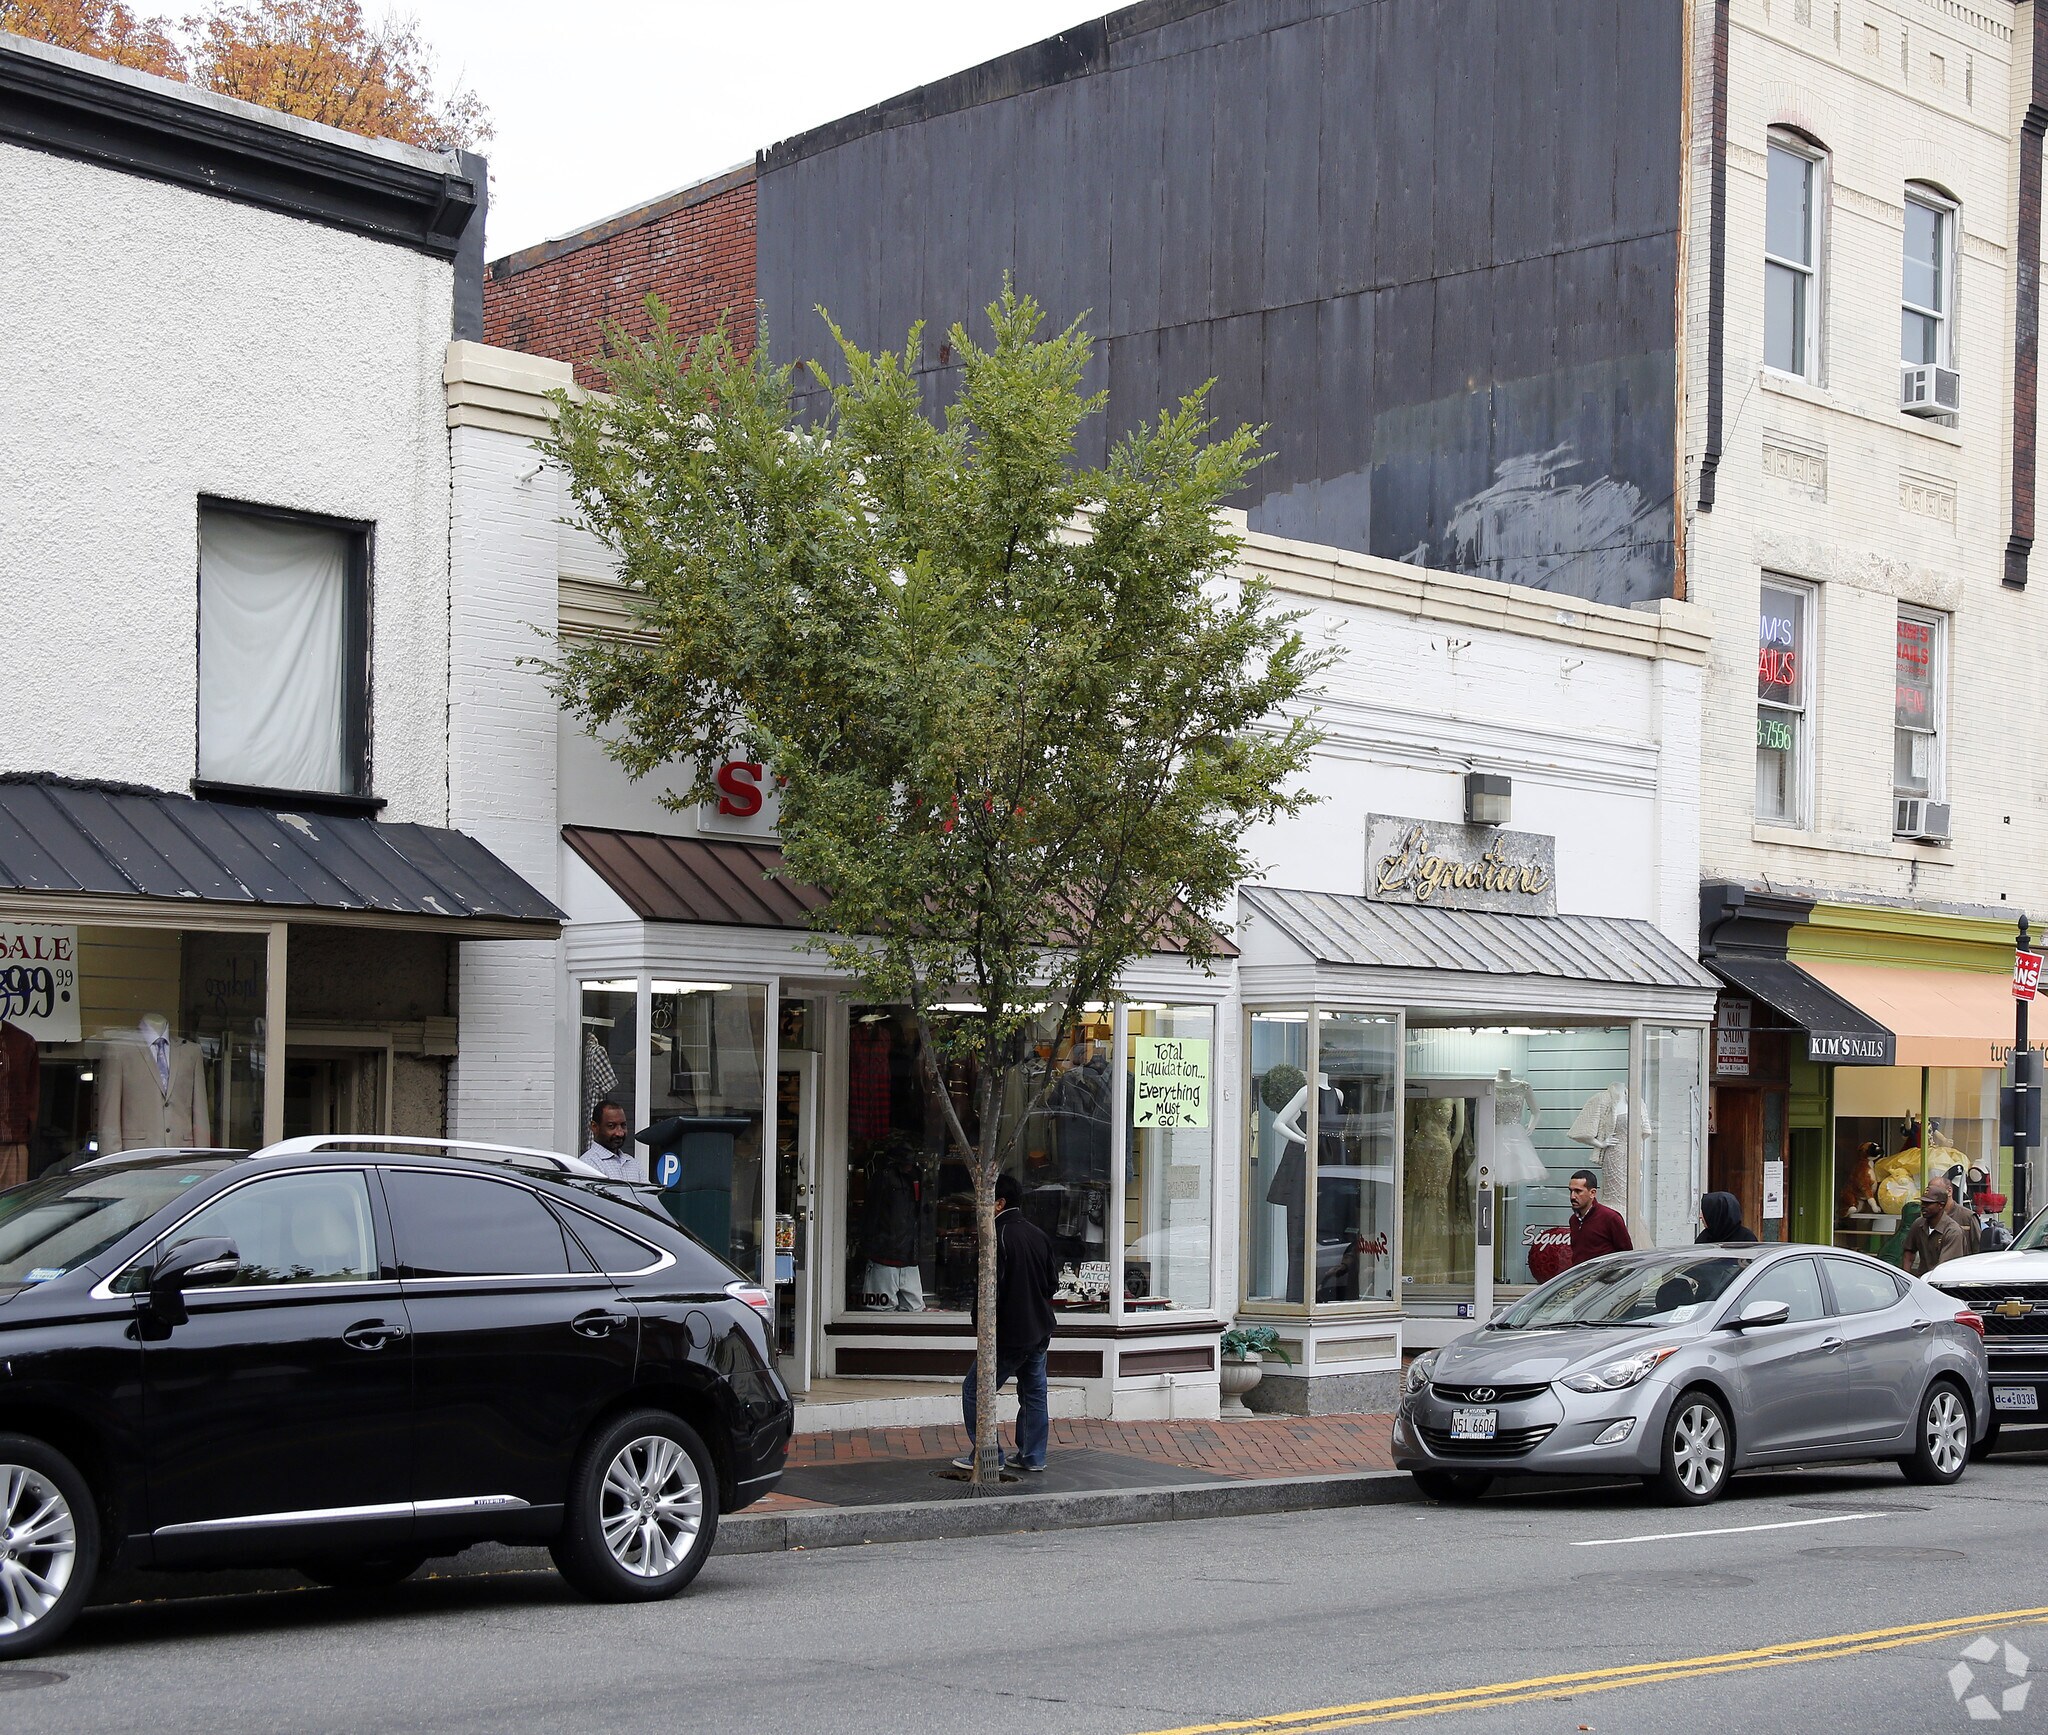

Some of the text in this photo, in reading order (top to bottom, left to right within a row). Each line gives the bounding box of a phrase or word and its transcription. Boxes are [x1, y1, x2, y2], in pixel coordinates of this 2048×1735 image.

[1375, 825, 1550, 901] Signature
[1727, 1011, 1742, 1027] NAIL
[1811, 1035, 1883, 1058] KIM'S NAILS
[1139, 1082, 1200, 1107] Everything
[1158, 1114, 1179, 1127] GO!
[663, 1155, 678, 1185] P
[1452, 1418, 1494, 1433] N51 6606
